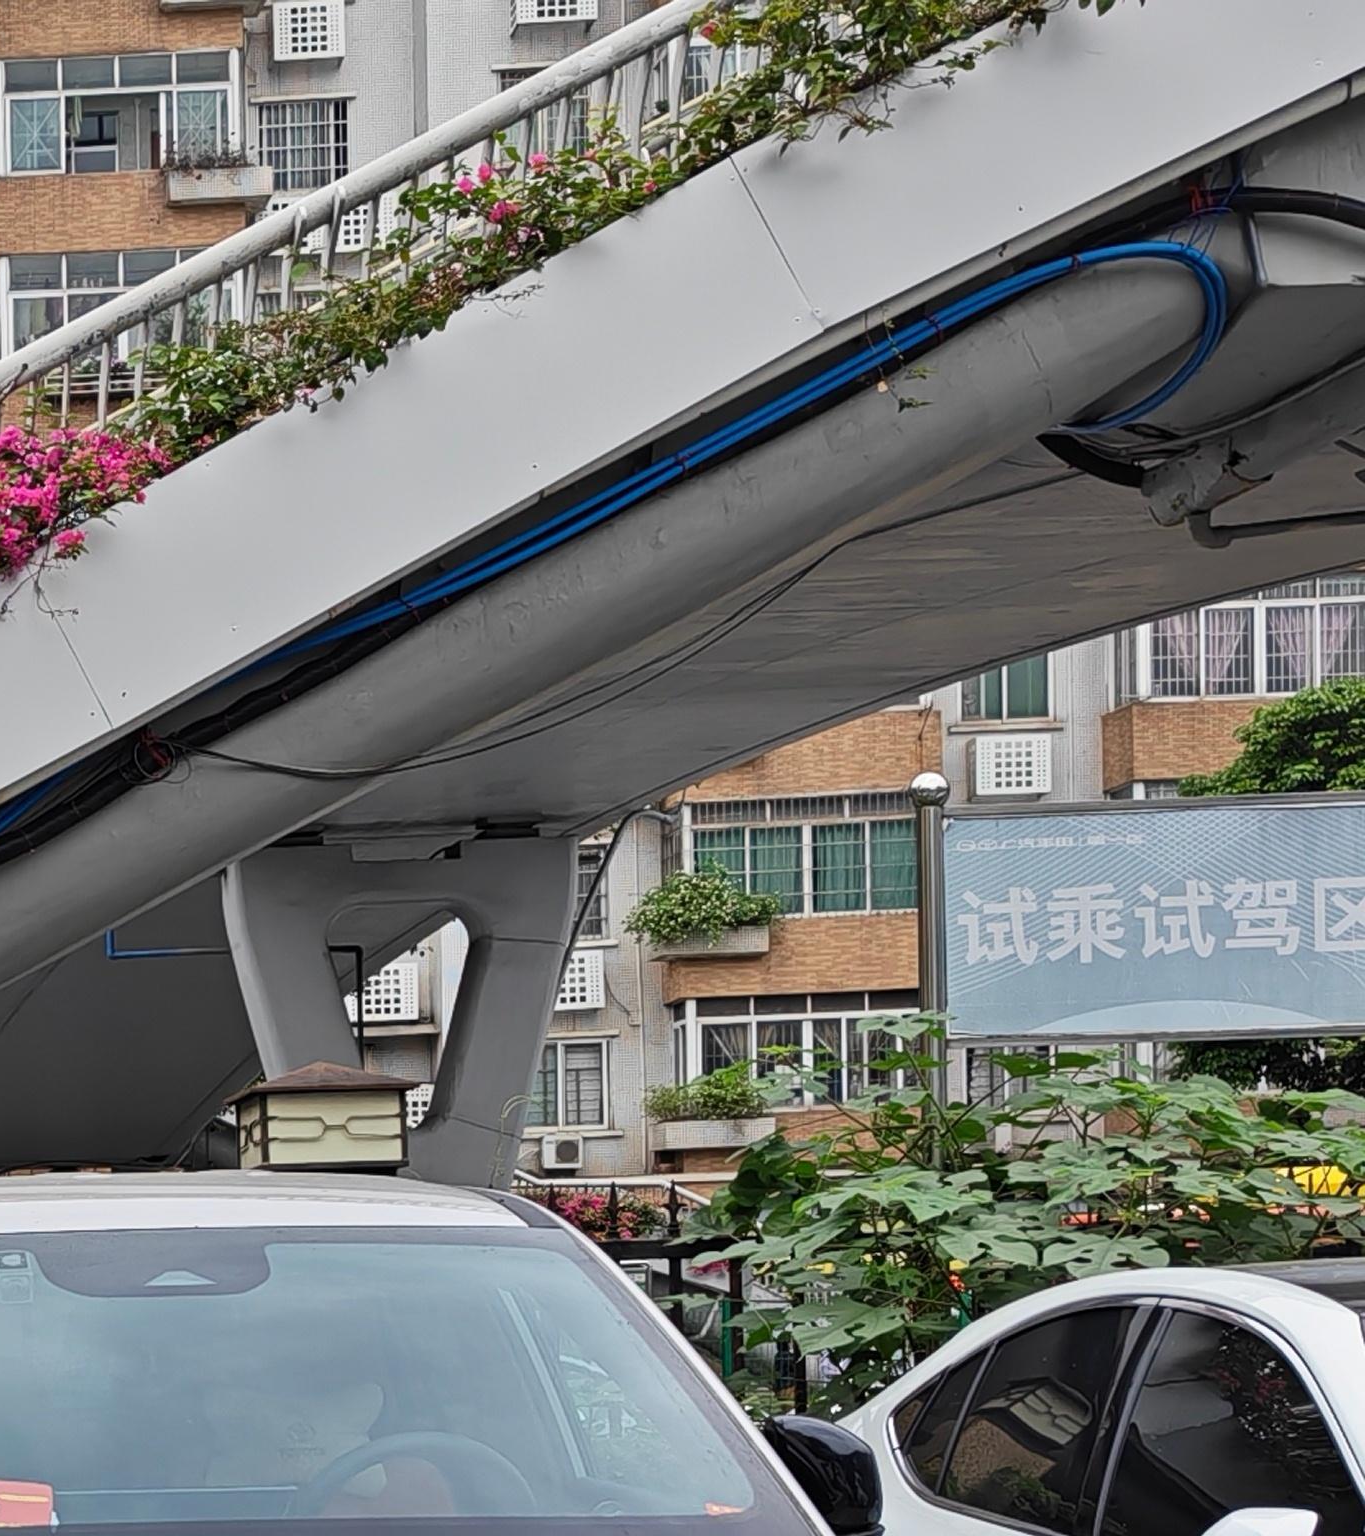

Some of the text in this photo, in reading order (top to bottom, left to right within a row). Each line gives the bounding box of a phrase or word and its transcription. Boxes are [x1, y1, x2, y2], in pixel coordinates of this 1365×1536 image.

[958, 877, 1365, 965] 试乘试驾区
